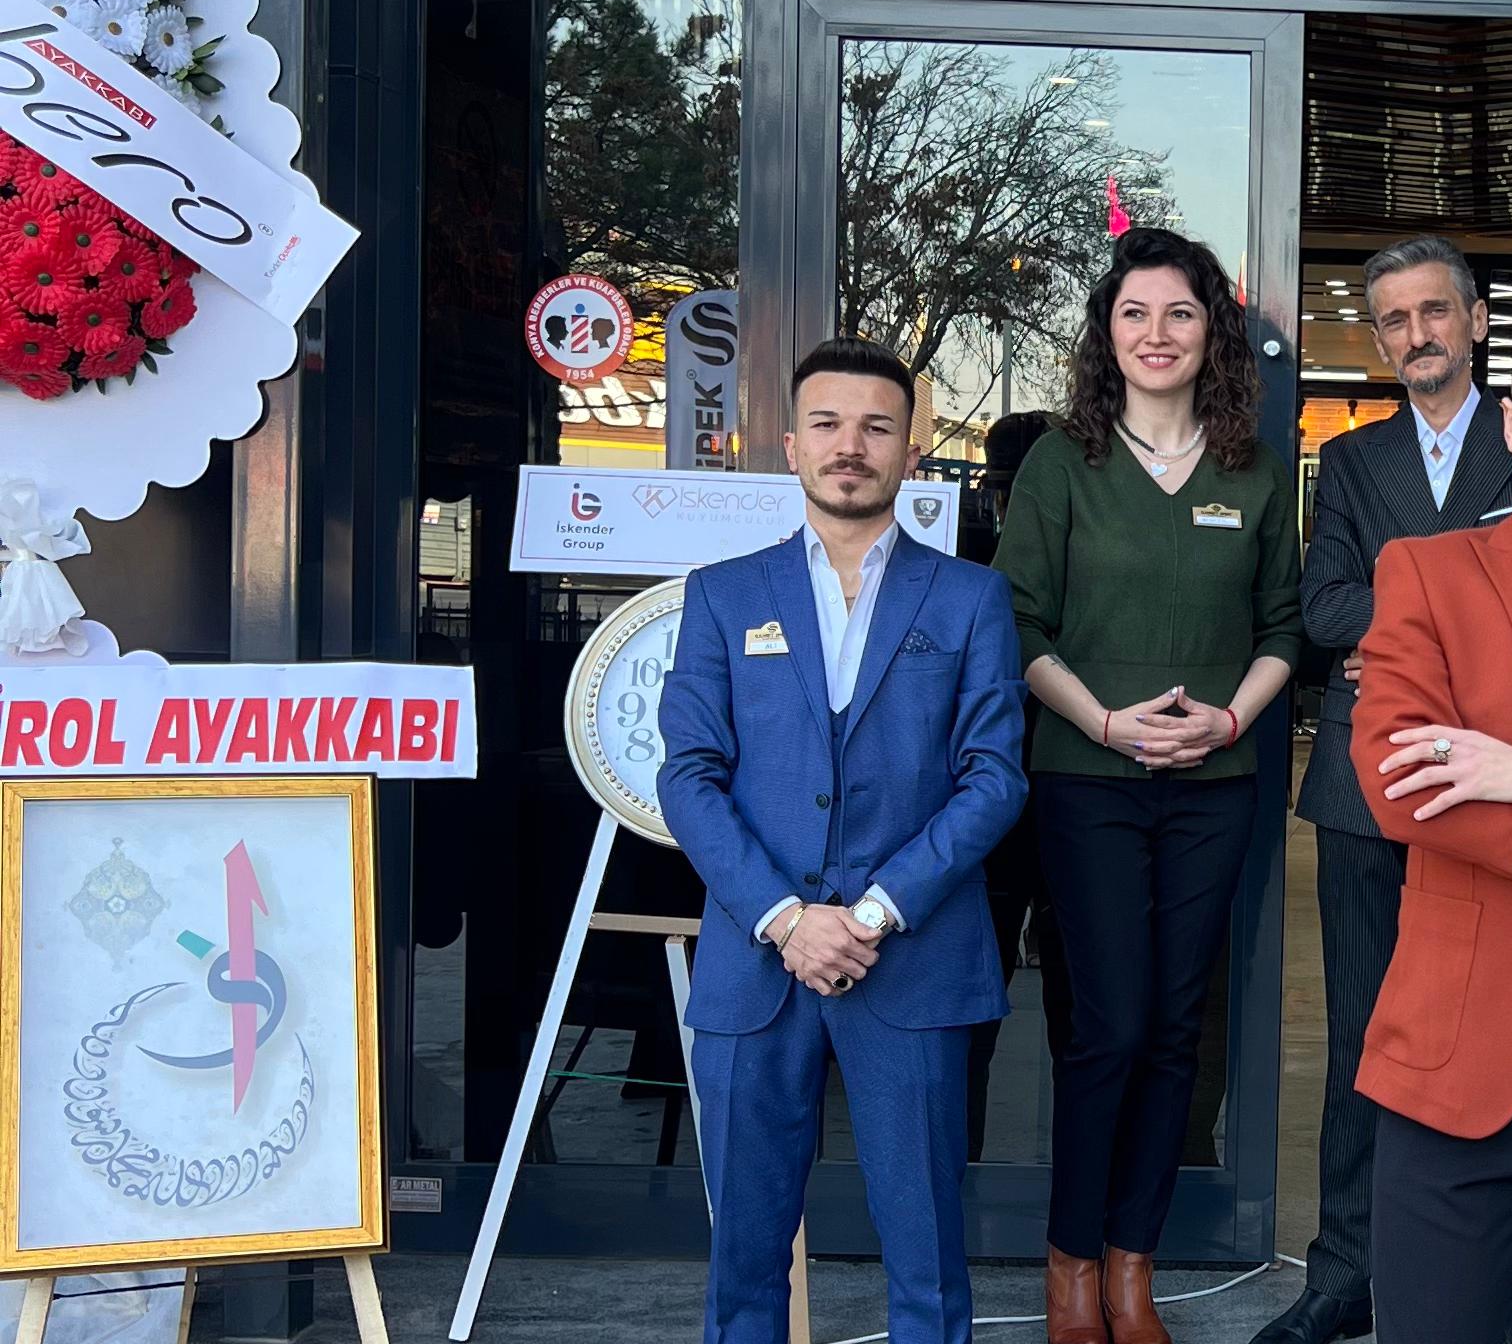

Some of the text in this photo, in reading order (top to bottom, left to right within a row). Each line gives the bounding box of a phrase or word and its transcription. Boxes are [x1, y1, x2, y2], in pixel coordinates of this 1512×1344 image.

[27, 40, 154, 128] AYAKKABI
[573, 277, 588, 287] VE
[527, 277, 572, 323] BERBERLER
[527, 323, 545, 359] KONYA
[565, 368, 596, 381] 1954
[562, 538, 605, 551] Group
[630, 657, 664, 688] 10
[616, 691, 648, 728] 9
[0, 696, 459, 767] ROL AYAKKABI
[624, 728, 657, 763] 8
